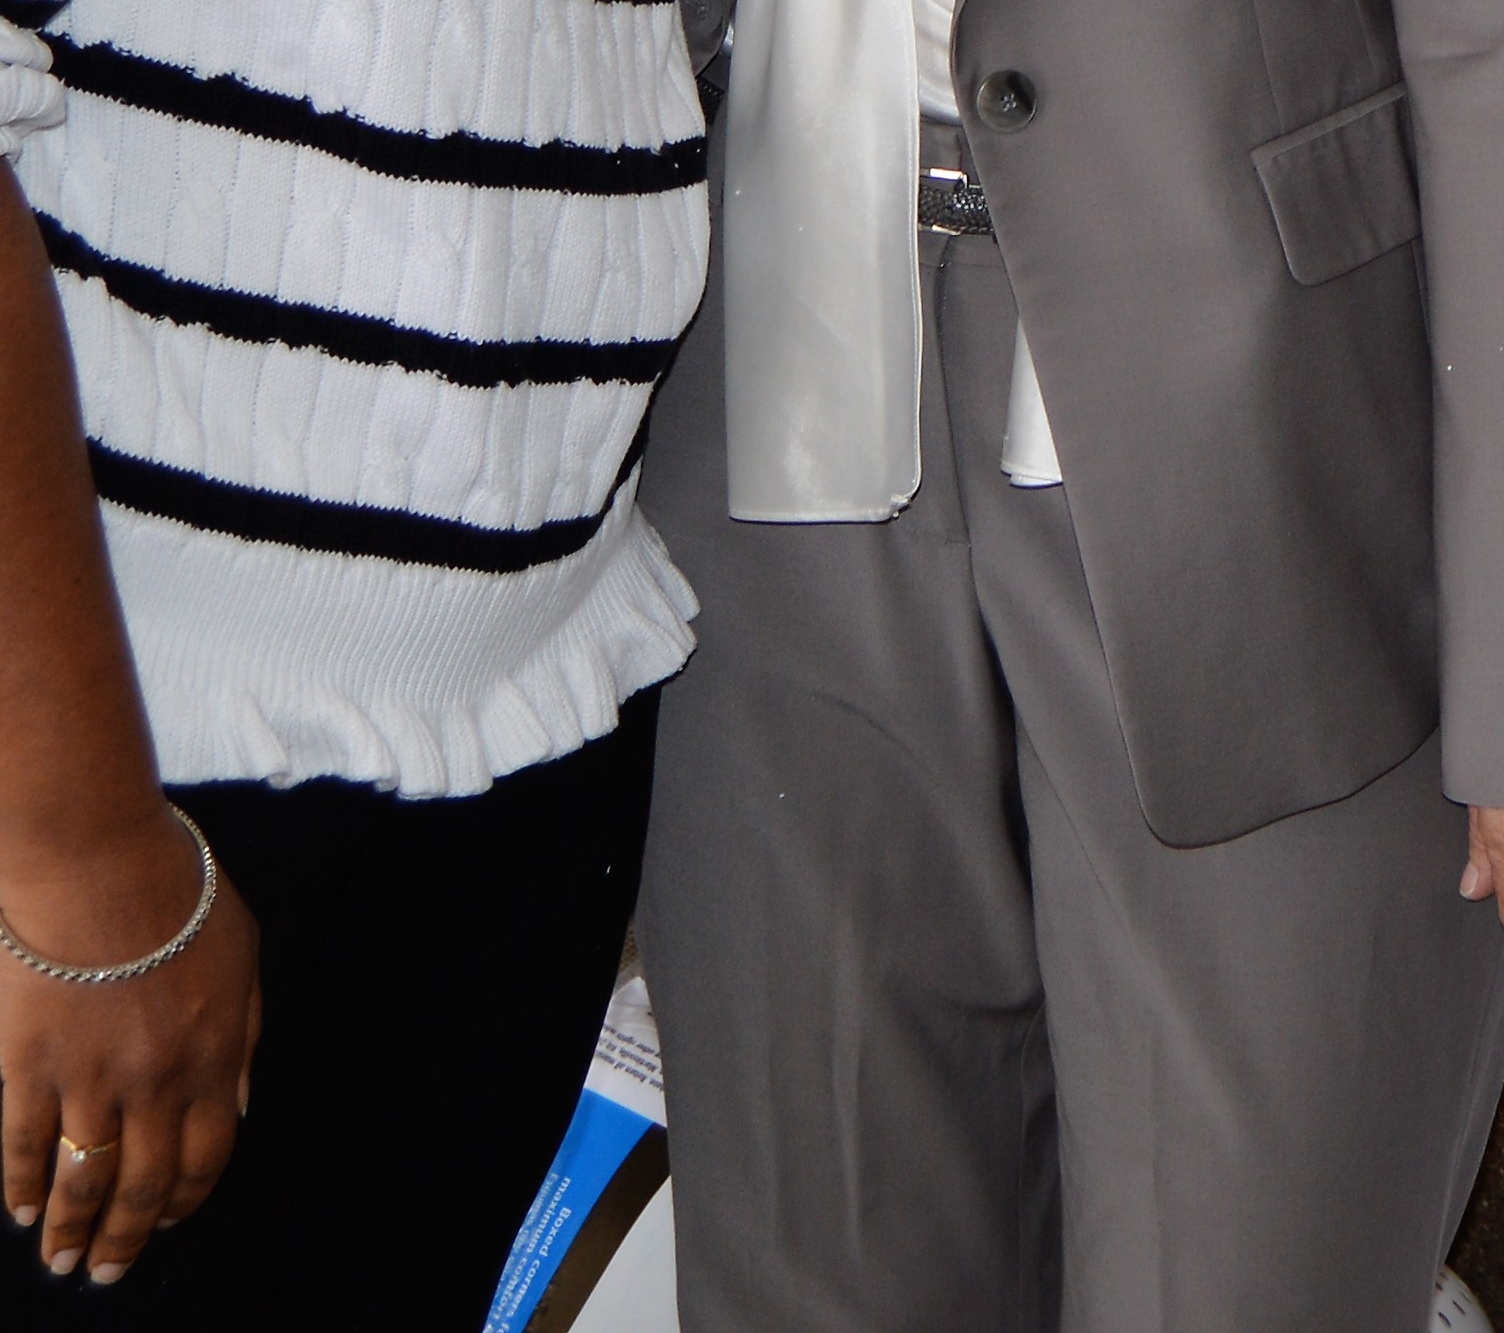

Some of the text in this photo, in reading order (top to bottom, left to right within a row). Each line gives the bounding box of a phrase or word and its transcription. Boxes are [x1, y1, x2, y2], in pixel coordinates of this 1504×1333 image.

[526, 1177, 571, 1254] maximum
[539, 1207, 572, 1257] Boxed
[493, 1257, 528, 1320] comfort
[506, 1259, 541, 1317] corners
